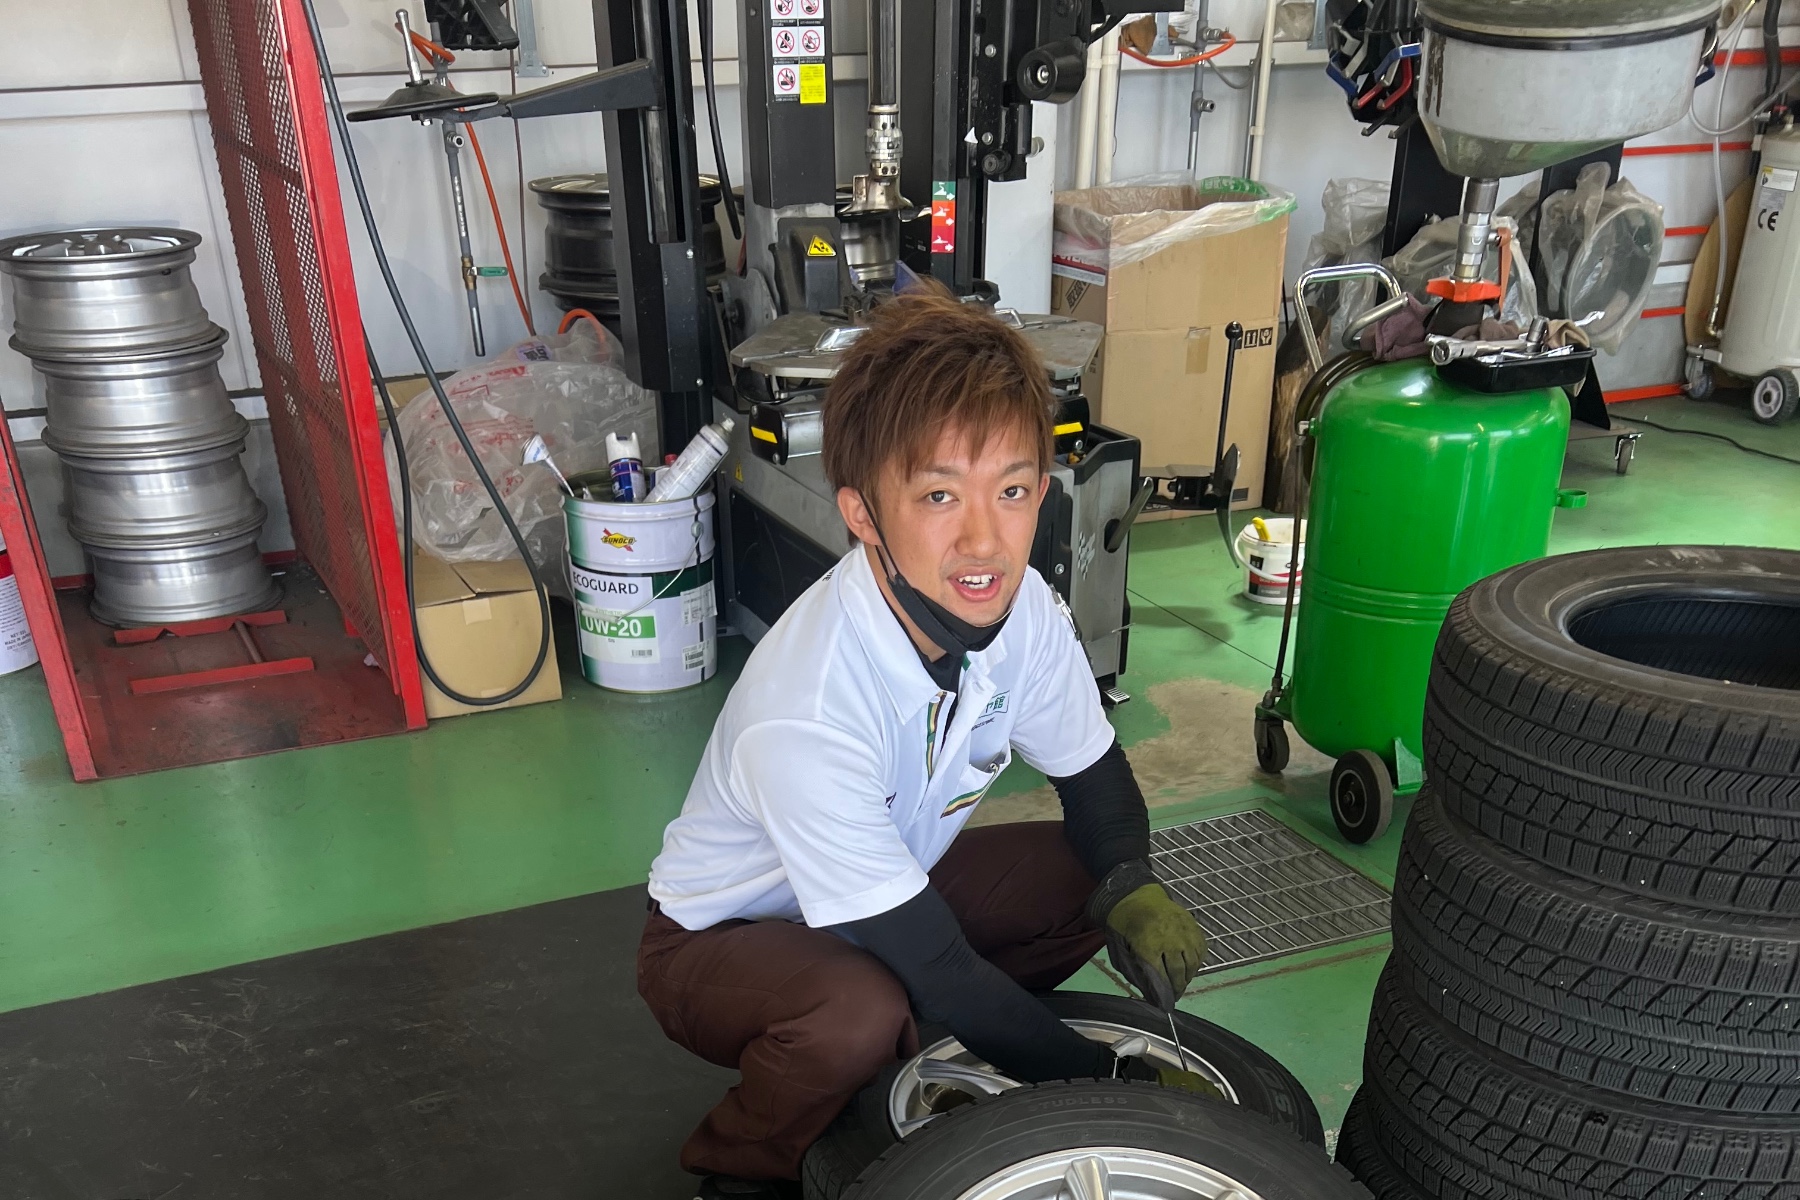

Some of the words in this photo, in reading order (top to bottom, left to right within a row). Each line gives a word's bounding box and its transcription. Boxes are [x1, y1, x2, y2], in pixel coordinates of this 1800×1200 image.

[1757, 207, 1779, 231] CE
[602, 536, 635, 545] SUNOCO
[572, 571, 639, 595] ECOGUARD
[585, 616, 642, 637] 0W-20
[986, 695, 1006, 713] ヤ館
[1027, 1096, 1128, 1112] STUDLESS
